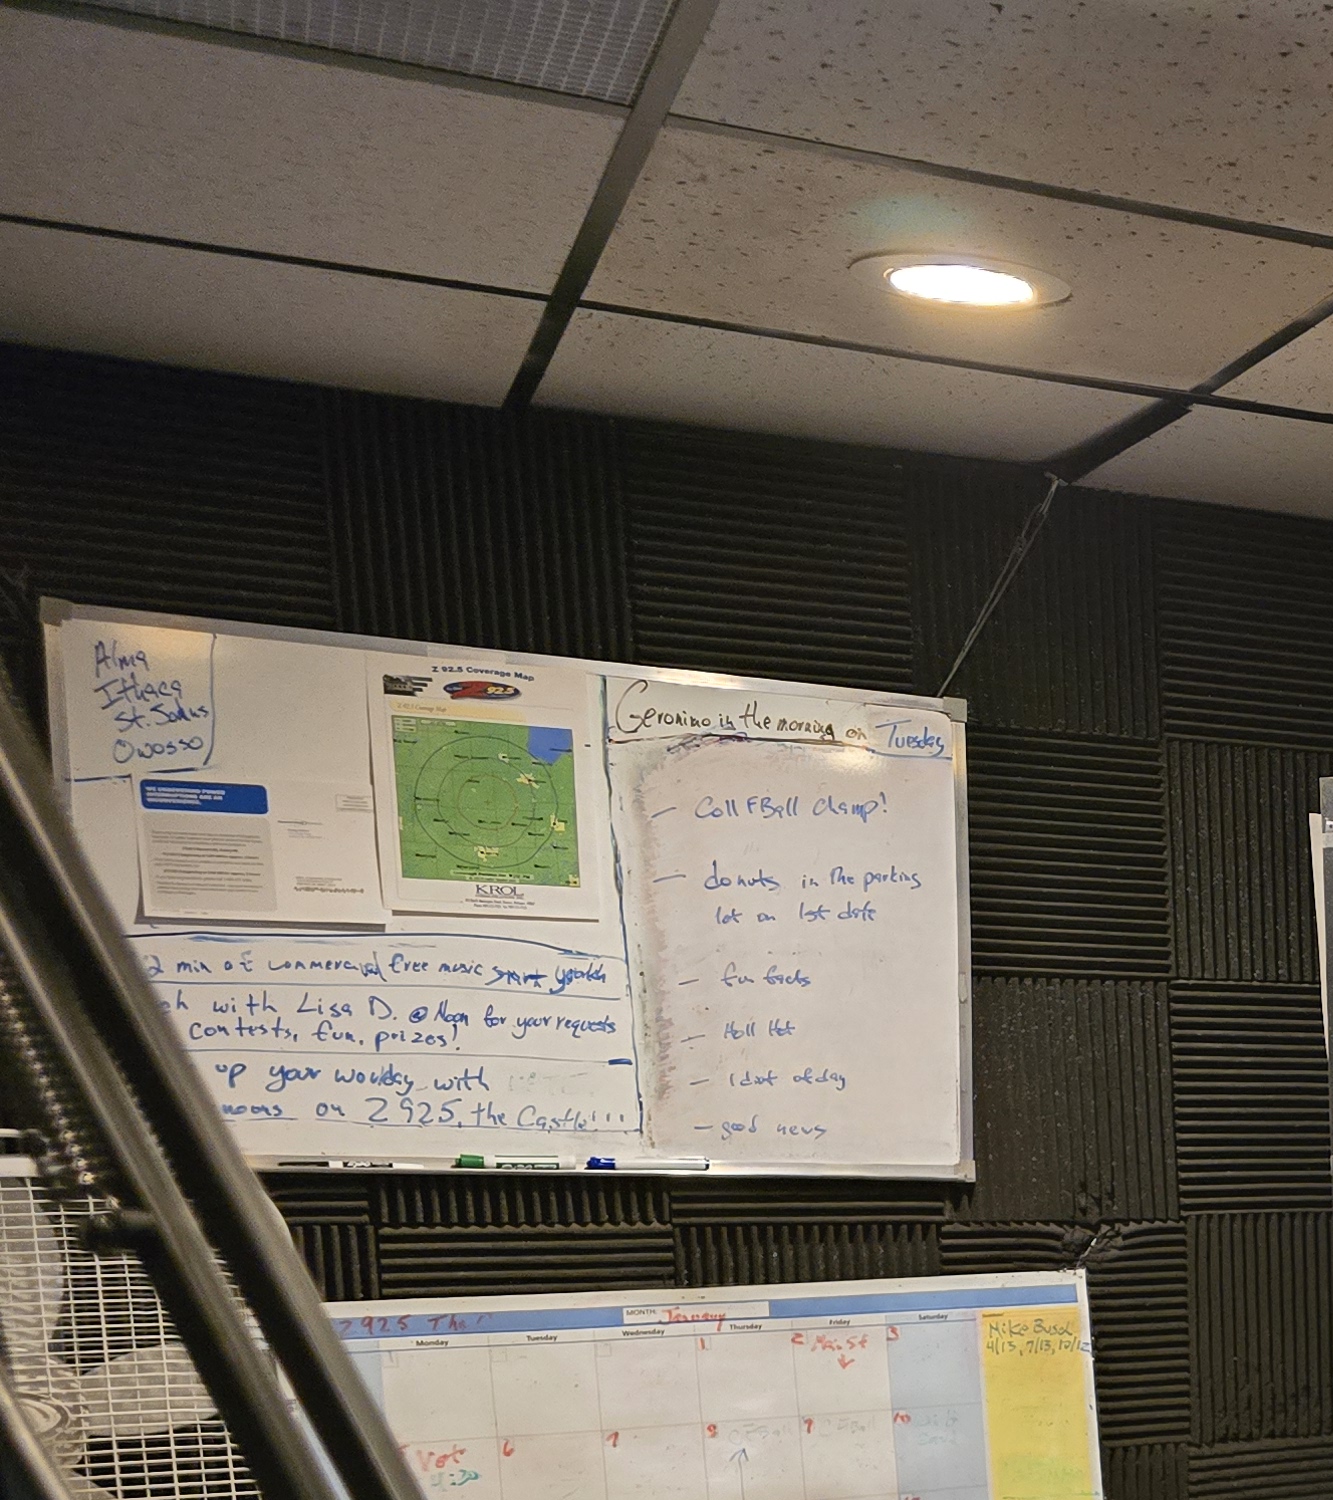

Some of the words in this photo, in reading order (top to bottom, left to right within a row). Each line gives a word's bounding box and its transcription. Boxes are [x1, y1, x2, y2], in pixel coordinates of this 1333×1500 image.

[95, 640, 149, 677] Alma
[466, 667, 511, 678] Coverage
[514, 672, 535, 682] Map
[94, 672, 182, 710] Ithaca
[486, 685, 515, 695] 92.5
[614, 679, 711, 734] Geronimo
[718, 712, 735, 730] in
[739, 701, 771, 729] the
[875, 719, 945, 757] Tuesday
[112, 736, 203, 763] Owosso
[177, 961, 212, 974] min
[388, 953, 429, 975] free
[438, 959, 483, 976] music
[213, 990, 278, 1016] with
[297, 992, 352, 1018] Lisa
[215, 1063, 247, 1088] up
[265, 1064, 321, 1092] your
[434, 1066, 489, 1091] with
[316, 1102, 345, 1117] on
[471, 1101, 506, 1127] the
[721, 1114, 759, 1140] good
[777, 1126, 826, 1140] news
[416, 1339, 449, 1347] Monday
[526, 1334, 558, 1342] Tuesday
[622, 1328, 665, 1337] Wednesday
[729, 1323, 763, 1331] Thursday
[829, 1318, 850, 1326] Friday
[918, 1313, 948, 1321] Saturday
[791, 1333, 804, 1345] 2
[886, 1326, 899, 1341] 3
[989, 1319, 1029, 1338] Mike
[503, 1440, 515, 1457] 6
